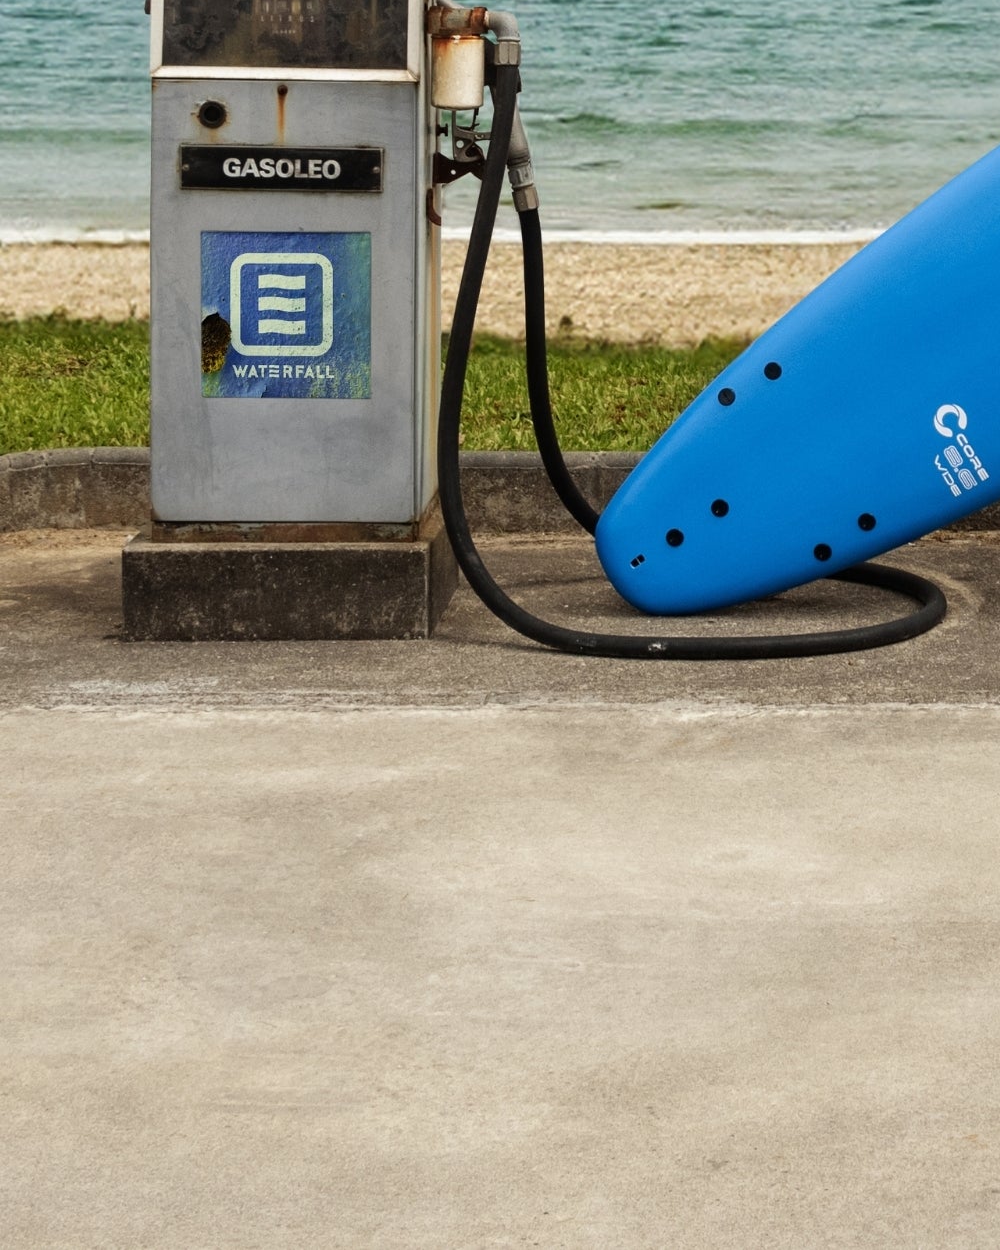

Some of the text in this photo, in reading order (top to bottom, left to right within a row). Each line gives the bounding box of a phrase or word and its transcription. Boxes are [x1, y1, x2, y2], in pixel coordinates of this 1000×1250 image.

[222, 157, 342, 180] GASOLEO
[232, 364, 335, 379] WATERFALL
[934, 454, 962, 497] WIDE
[943, 445, 978, 490] 8.6
[956, 433, 990, 482] CORE
